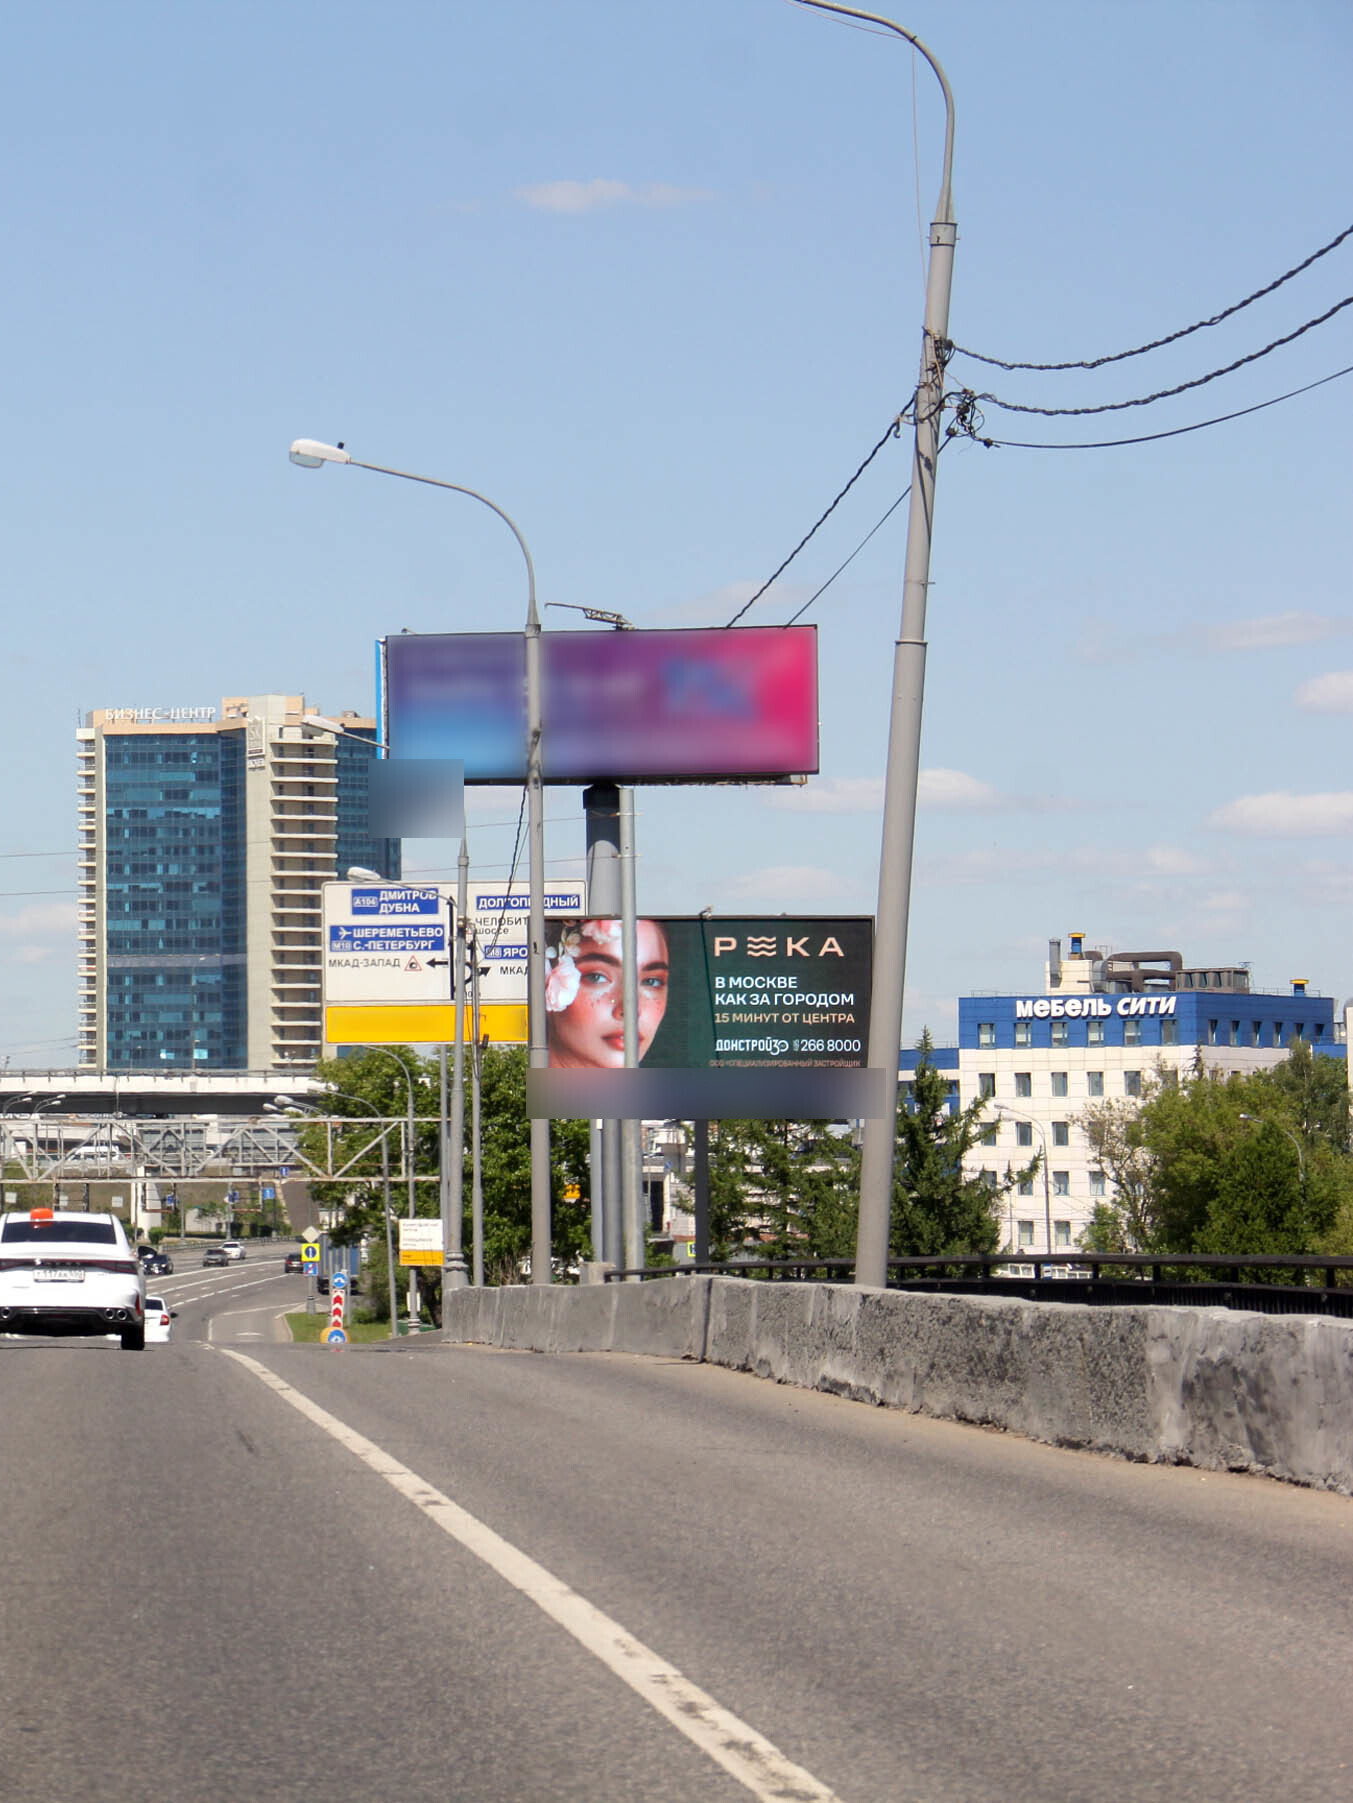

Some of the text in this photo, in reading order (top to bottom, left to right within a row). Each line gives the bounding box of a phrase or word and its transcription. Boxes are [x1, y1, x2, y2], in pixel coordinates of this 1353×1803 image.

[379, 890, 437, 901] ДМИТРОВ
[379, 903, 420, 914] ДУБНА
[478, 897, 579, 909] ДОЛГОПДНЫЙ
[353, 928, 443, 938] ШЕРЕМЕТЬЕВО
[353, 940, 436, 950] С.-ПЕТЕРБУРГ
[328, 959, 401, 969] МКАД-ЗАПАД
[715, 977, 798, 988] В МОСКВЕ
[715, 993, 854, 1008] КАК ЗА ГОРОДОМ
[1117, 996, 1177, 1017] СИТИ
[714, 1013, 855, 1025] 15 МИНУТ ОТ ЦЕНТРА
[800, 1039, 825, 1052] 266
[827, 1039, 861, 1052] 8000
